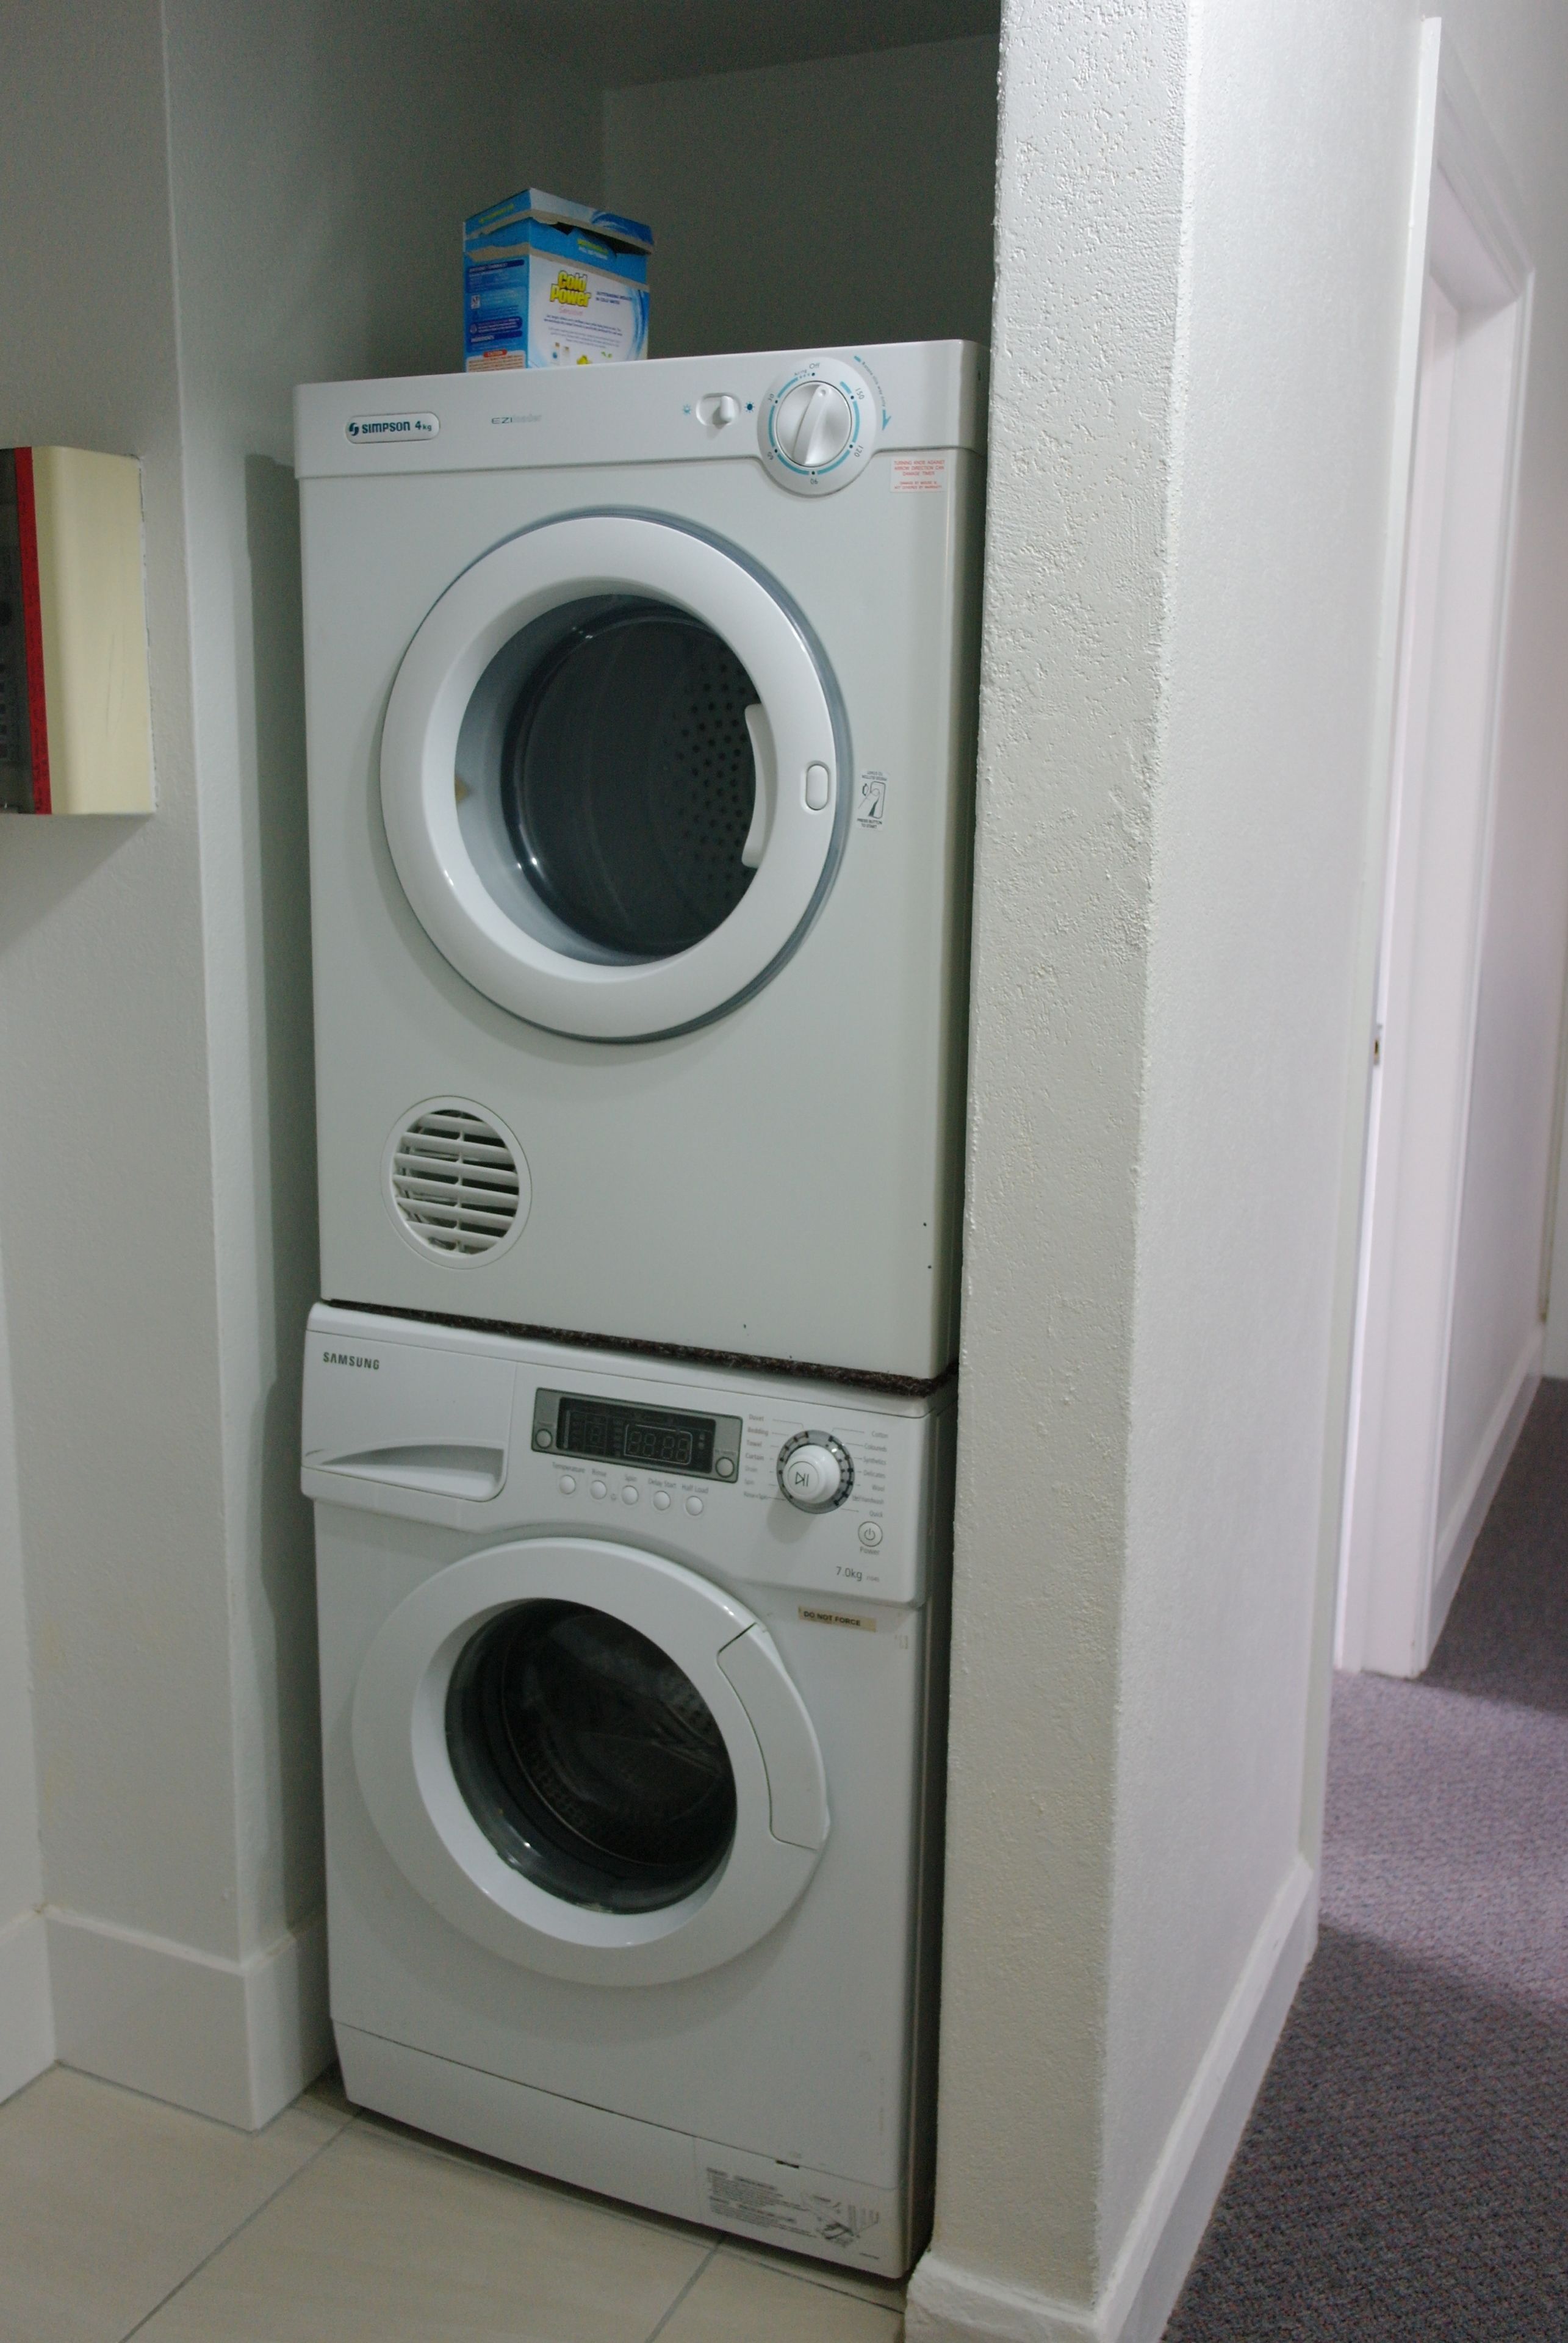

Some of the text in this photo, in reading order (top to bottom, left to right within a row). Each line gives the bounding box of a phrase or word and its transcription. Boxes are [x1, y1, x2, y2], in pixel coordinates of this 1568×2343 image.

[558, 270, 588, 292] Cold
[550, 283, 591, 308] Power
[855, 387, 865, 400] 150
[362, 421, 411, 434] SIMPSON
[854, 445, 864, 458] 120
[323, 1351, 379, 1370] SAMSUNG
[747, 1427, 769, 1436] Bedding
[552, 1461, 586, 1474] Temperature
[592, 1468, 607, 1477] Rinse
[648, 1478, 677, 1488] Delay Start
[694, 1484, 709, 1494] Load
[860, 1546, 880, 1555] Power
[836, 1566, 863, 1582] 7.0kg
[817, 1613, 832, 1621] NOT
[835, 1616, 861, 1626] FORCE
